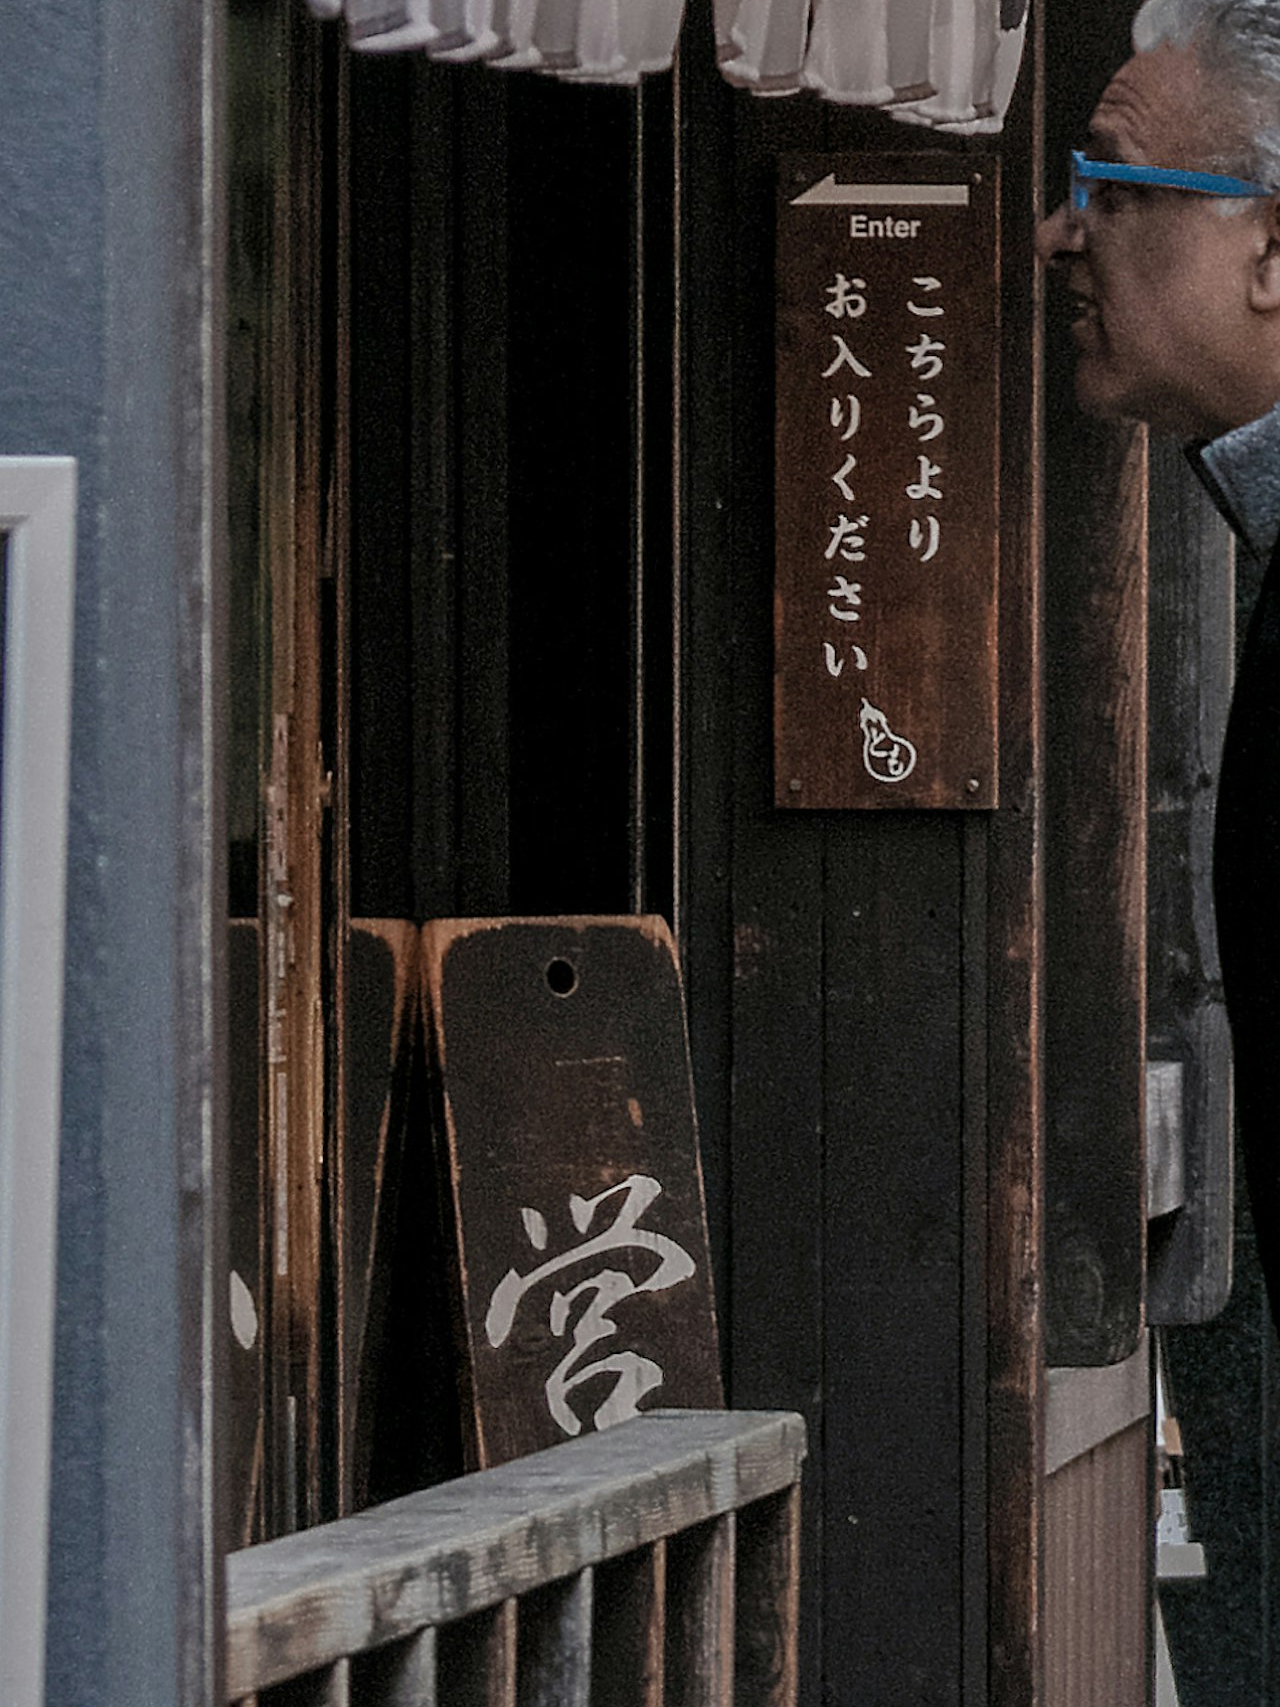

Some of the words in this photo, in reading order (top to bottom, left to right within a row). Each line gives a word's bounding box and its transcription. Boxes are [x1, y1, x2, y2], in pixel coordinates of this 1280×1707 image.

[849, 215, 922, 239] Enter
[822, 273, 872, 679] お入りください
[904, 275, 946, 563] こちらより
